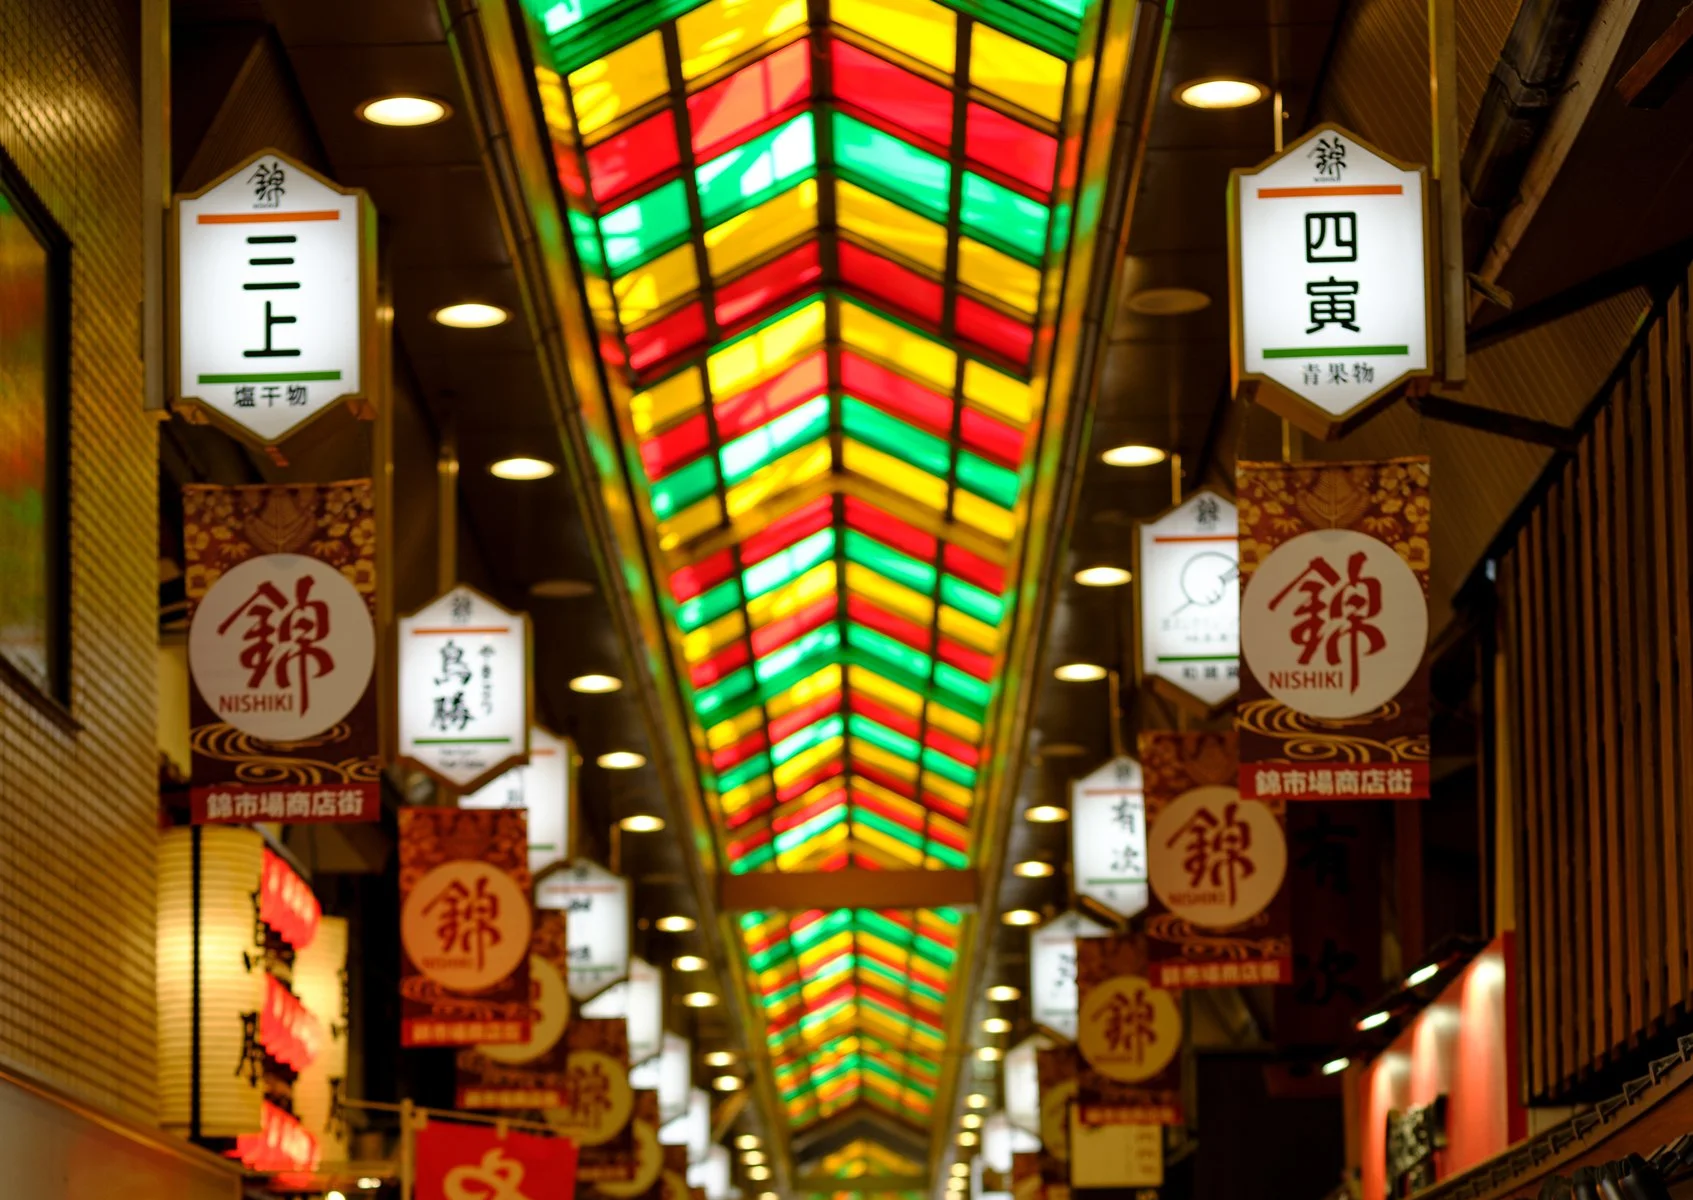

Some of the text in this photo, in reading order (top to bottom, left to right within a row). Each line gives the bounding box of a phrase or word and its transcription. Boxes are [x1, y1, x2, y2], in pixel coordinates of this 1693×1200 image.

[1307, 136, 1348, 180] 錦
[247, 161, 287, 208] 錦
[1305, 211, 1361, 335] 四寅
[242, 235, 301, 358] 三上
[234, 385, 308, 408] 塩干物
[1302, 363, 1375, 386] 青果物
[1267, 550, 1387, 696] 錦
[216, 574, 335, 719] 錦
[1268, 671, 1344, 690] NISHIKI
[219, 694, 293, 713] NISHIKI
[207, 790, 364, 819] 錦市場商店街
[1255, 769, 1412, 796] 錦市場商店街
[1166, 803, 1256, 908] 錦
[422, 876, 502, 973] 錦
